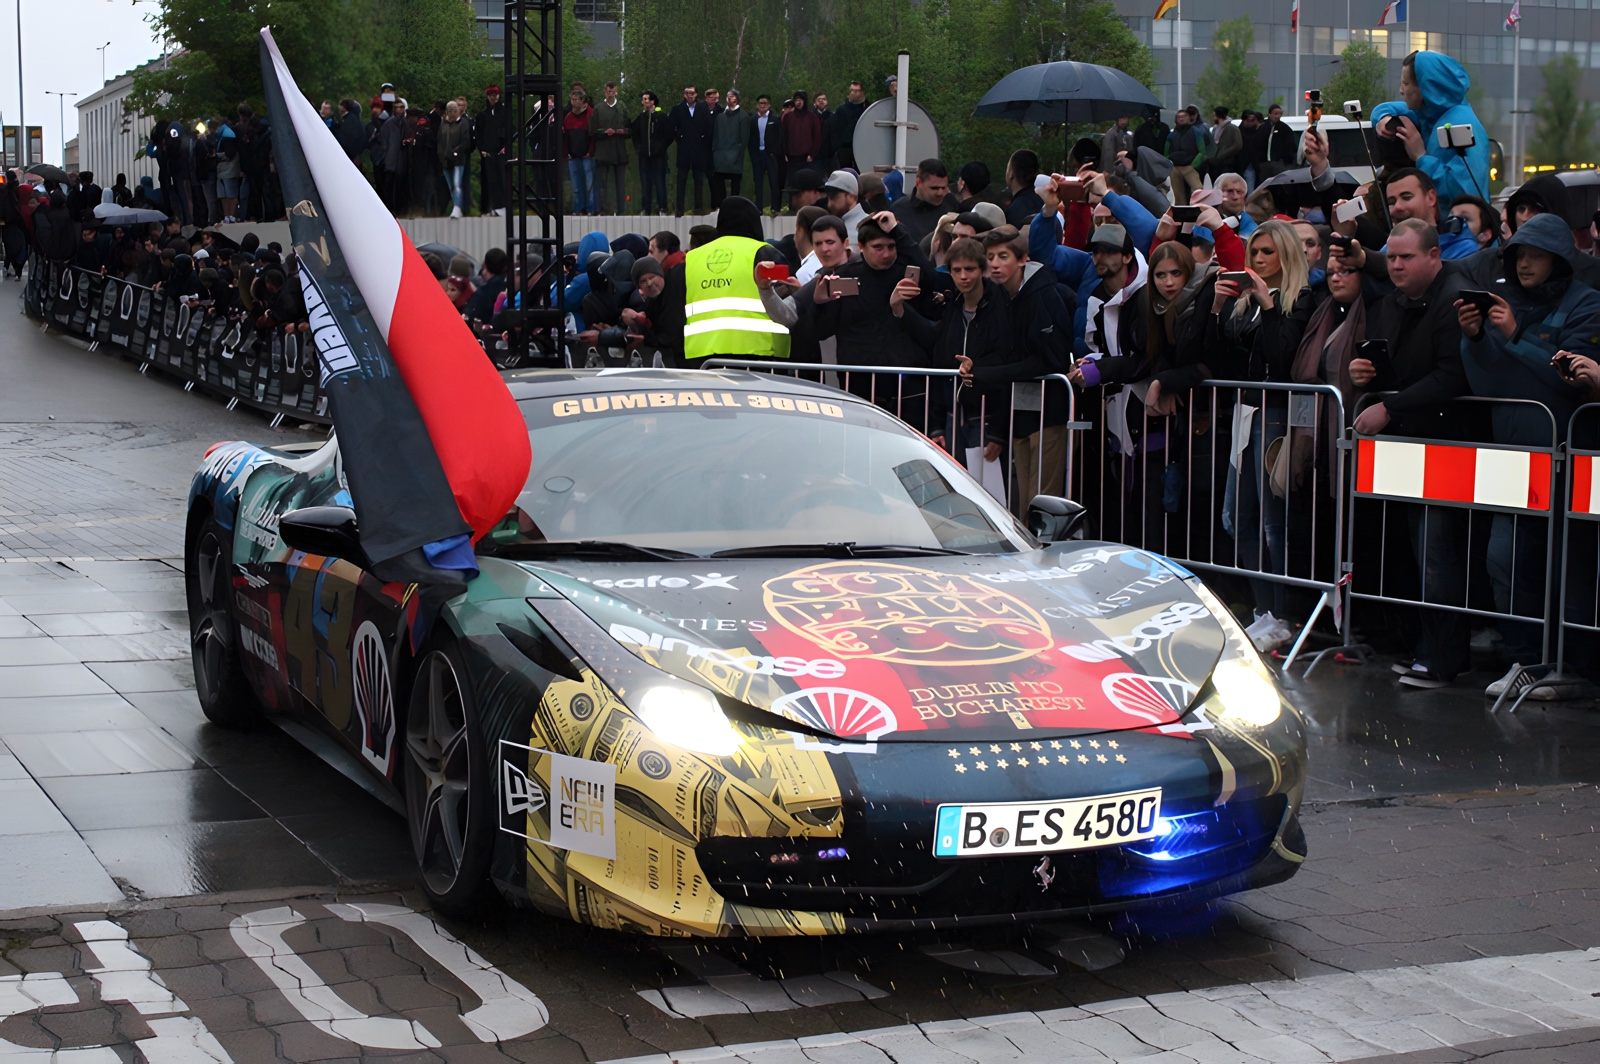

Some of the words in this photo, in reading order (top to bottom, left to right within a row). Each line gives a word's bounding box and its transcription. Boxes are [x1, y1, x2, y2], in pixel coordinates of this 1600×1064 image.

[552, 391, 742, 418] GUMBALL
[747, 394, 845, 418] 3000
[909, 681, 1021, 703] DUBLIN
[1020, 680, 1063, 695] TO
[912, 695, 1087, 721] BUCHAREST
[560, 775, 605, 809] NEW
[560, 803, 605, 837] ERA
[963, 811, 988, 849] B
[1014, 808, 1066, 847] ES
[1073, 796, 1157, 842] 4580
